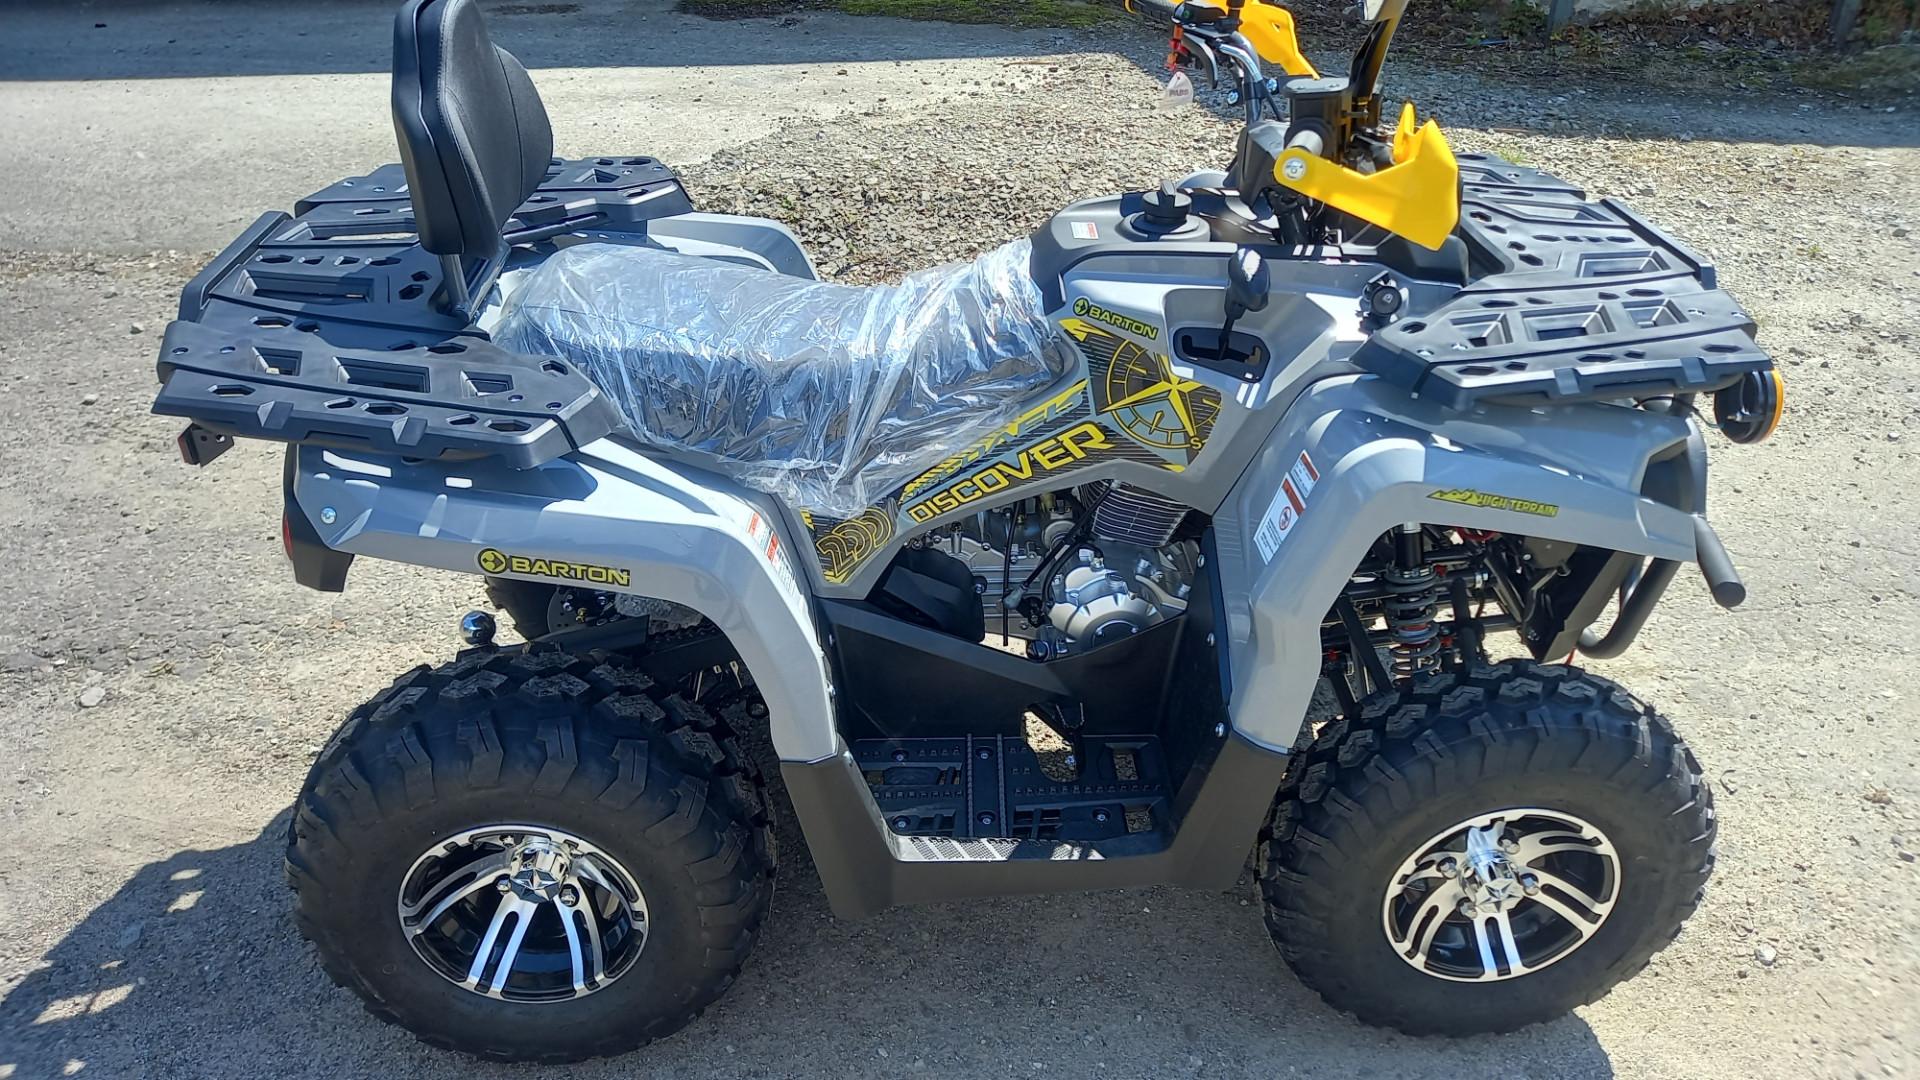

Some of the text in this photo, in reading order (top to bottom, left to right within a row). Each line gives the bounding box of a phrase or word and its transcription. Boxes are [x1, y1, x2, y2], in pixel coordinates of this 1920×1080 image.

[1088, 305, 1158, 340] BARTON
[908, 421, 1116, 524] DISCOVER
[510, 556, 630, 586] BARTON
